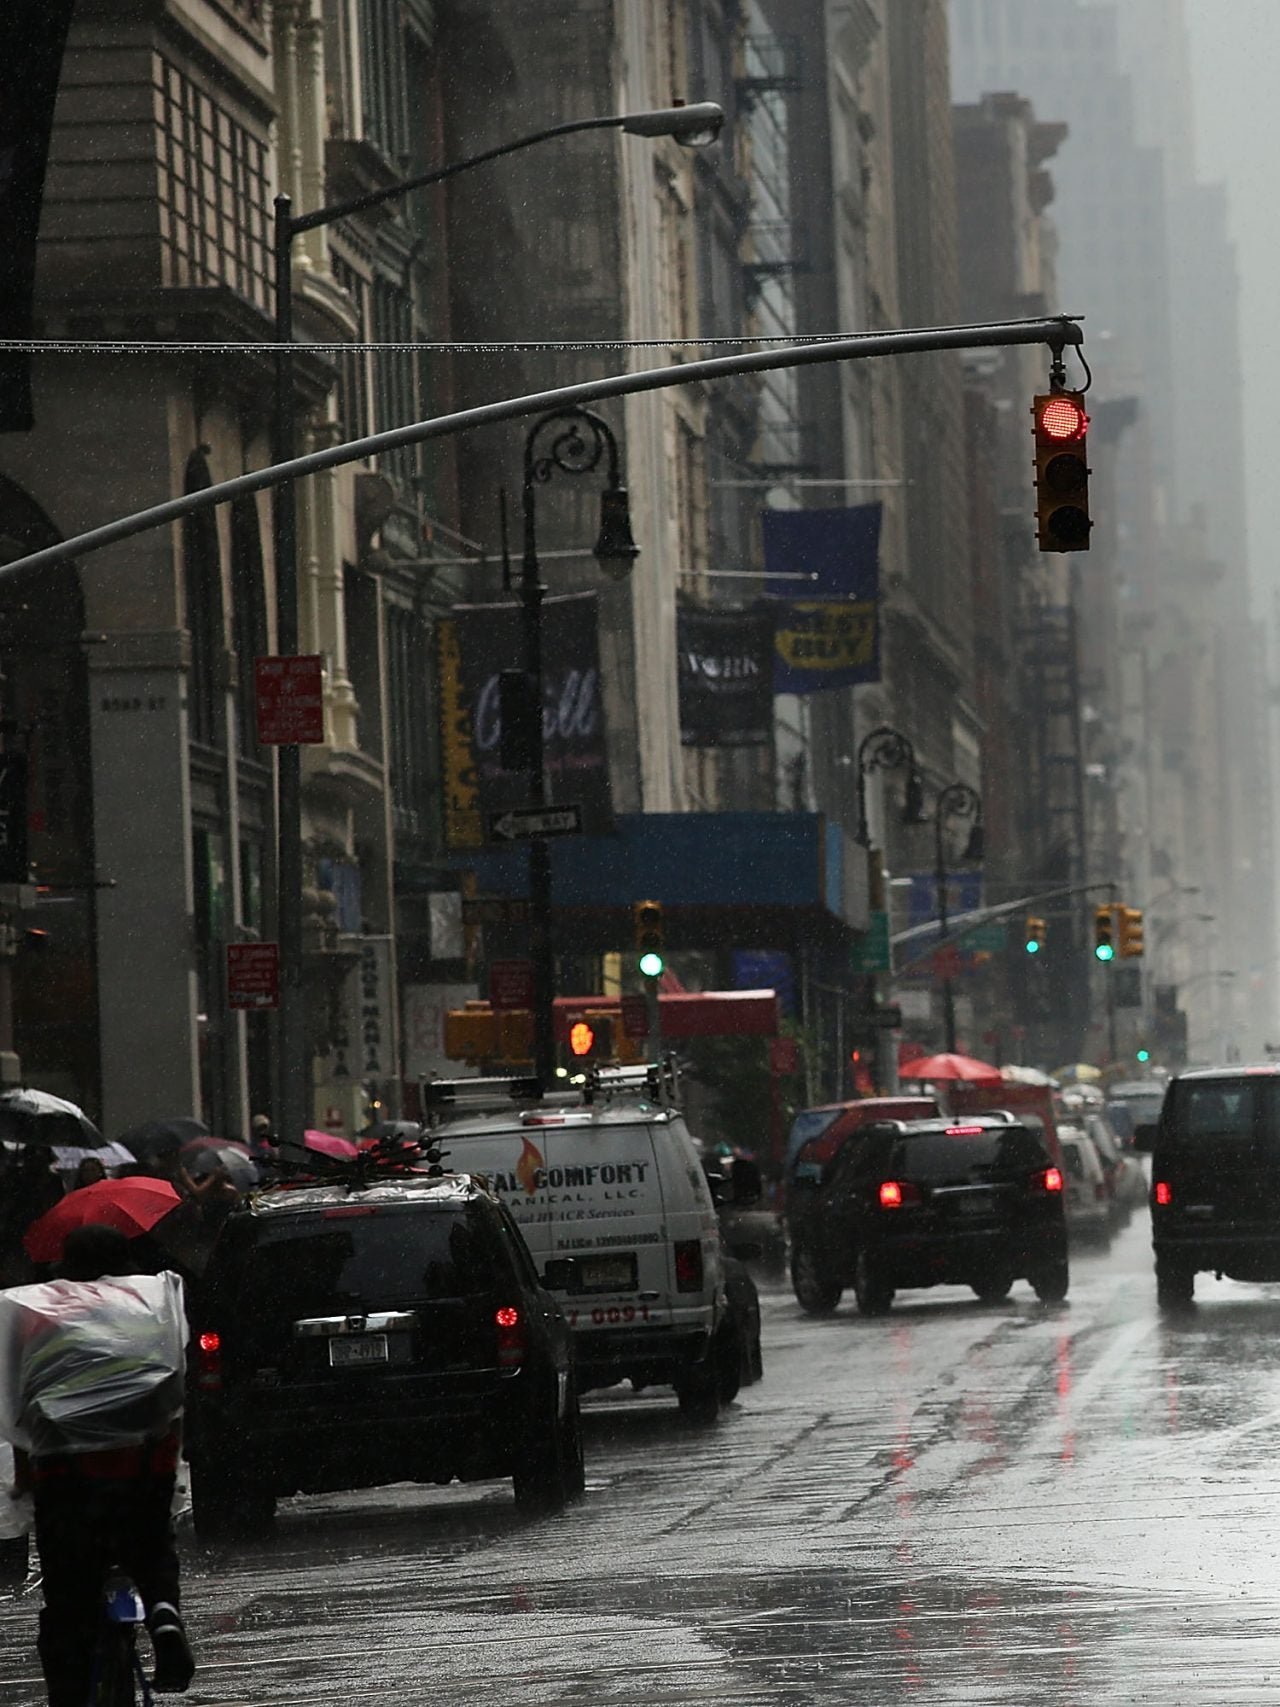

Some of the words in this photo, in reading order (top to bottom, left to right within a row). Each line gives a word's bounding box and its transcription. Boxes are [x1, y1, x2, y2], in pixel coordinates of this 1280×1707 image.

[791, 636, 863, 657] BUY
[361, 1004, 382, 1073] MANIA
[533, 1161, 650, 1189] COMFORT
[510, 1192, 593, 1207] ANICAL,
[587, 1208, 635, 1220] Services
[591, 1304, 651, 1325] 0091
